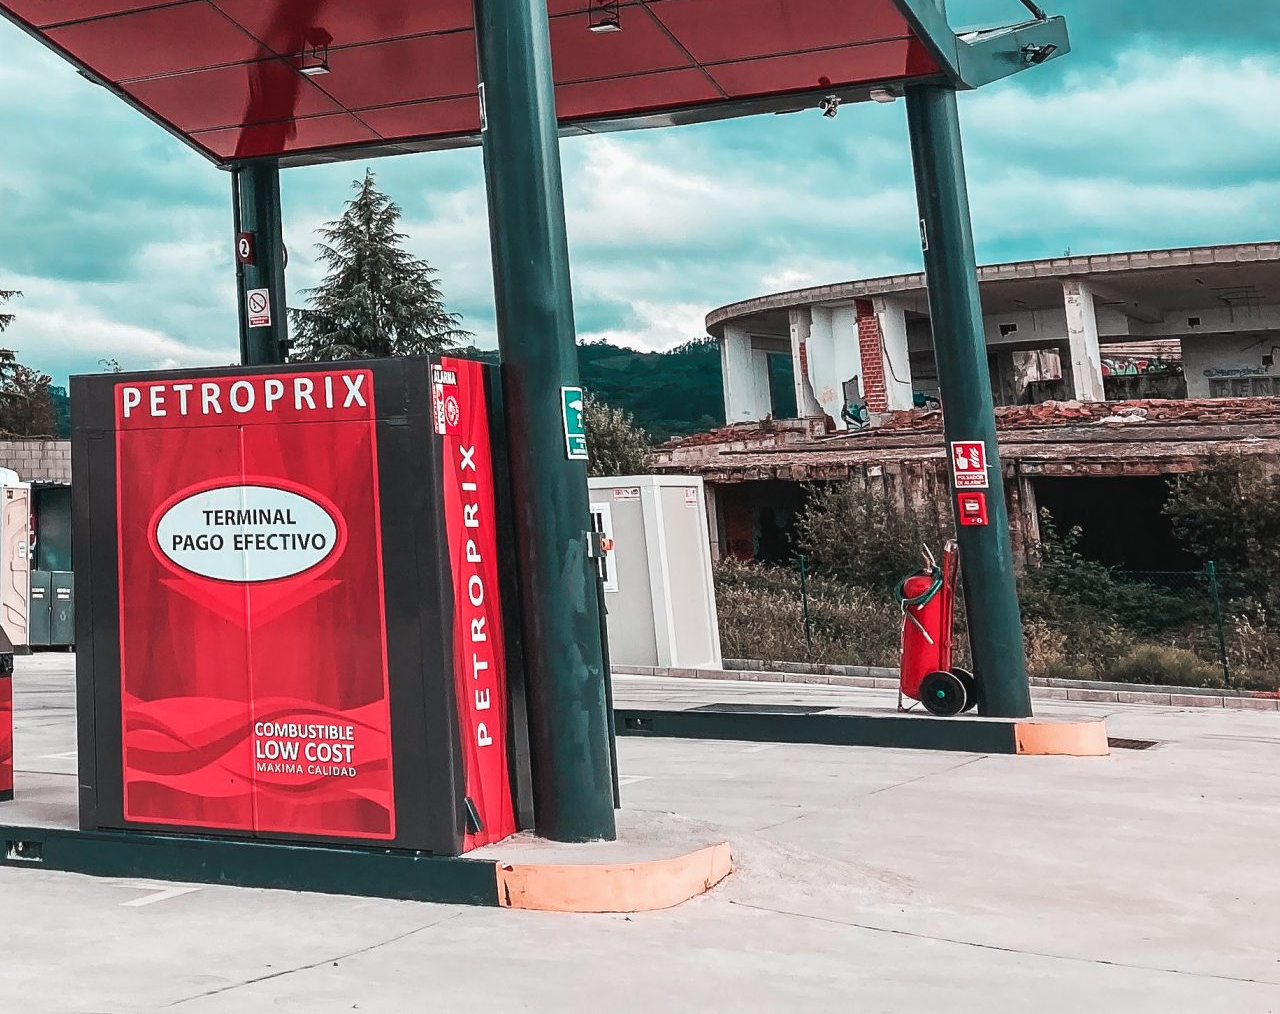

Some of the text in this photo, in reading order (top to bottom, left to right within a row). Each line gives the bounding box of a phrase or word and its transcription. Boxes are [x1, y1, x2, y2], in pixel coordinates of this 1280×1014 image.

[241, 240, 248, 255] 2
[433, 370, 457, 385] ALARMA
[123, 374, 367, 418] PETROPRIX
[202, 509, 297, 526] TERMINAL
[172, 533, 327, 551] PAGO EFECTIVO
[459, 444, 493, 747] PETROPRIX
[255, 722, 354, 740] COMBUSTIBLE
[256, 740, 355, 763] LOW COST
[257, 762, 357, 777] MAXIMA CALIDAD
